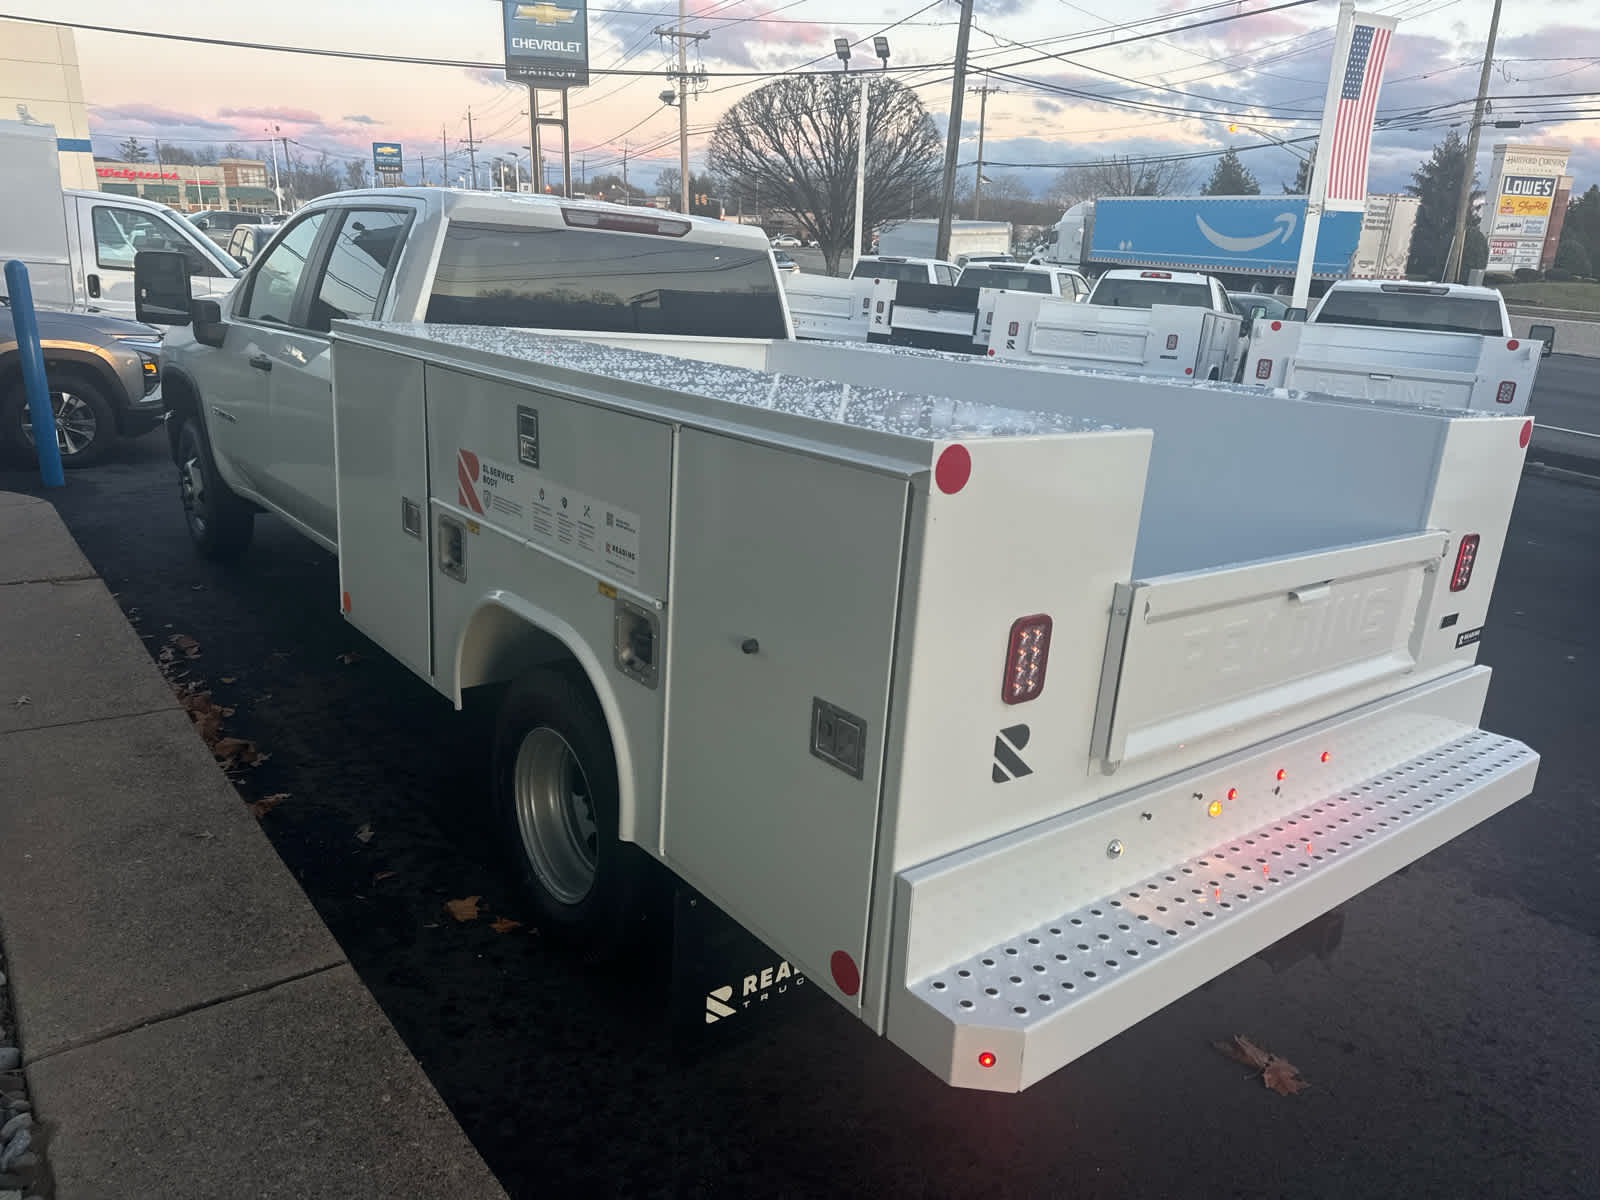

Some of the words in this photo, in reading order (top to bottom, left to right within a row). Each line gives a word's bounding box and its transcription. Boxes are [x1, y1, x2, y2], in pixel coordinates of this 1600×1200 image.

[511, 37, 582, 53] CHEVROLET
[1504, 177, 1552, 196] LOWE'S
[482, 474, 498, 488] BODY
[490, 467, 515, 484] SERVICE
